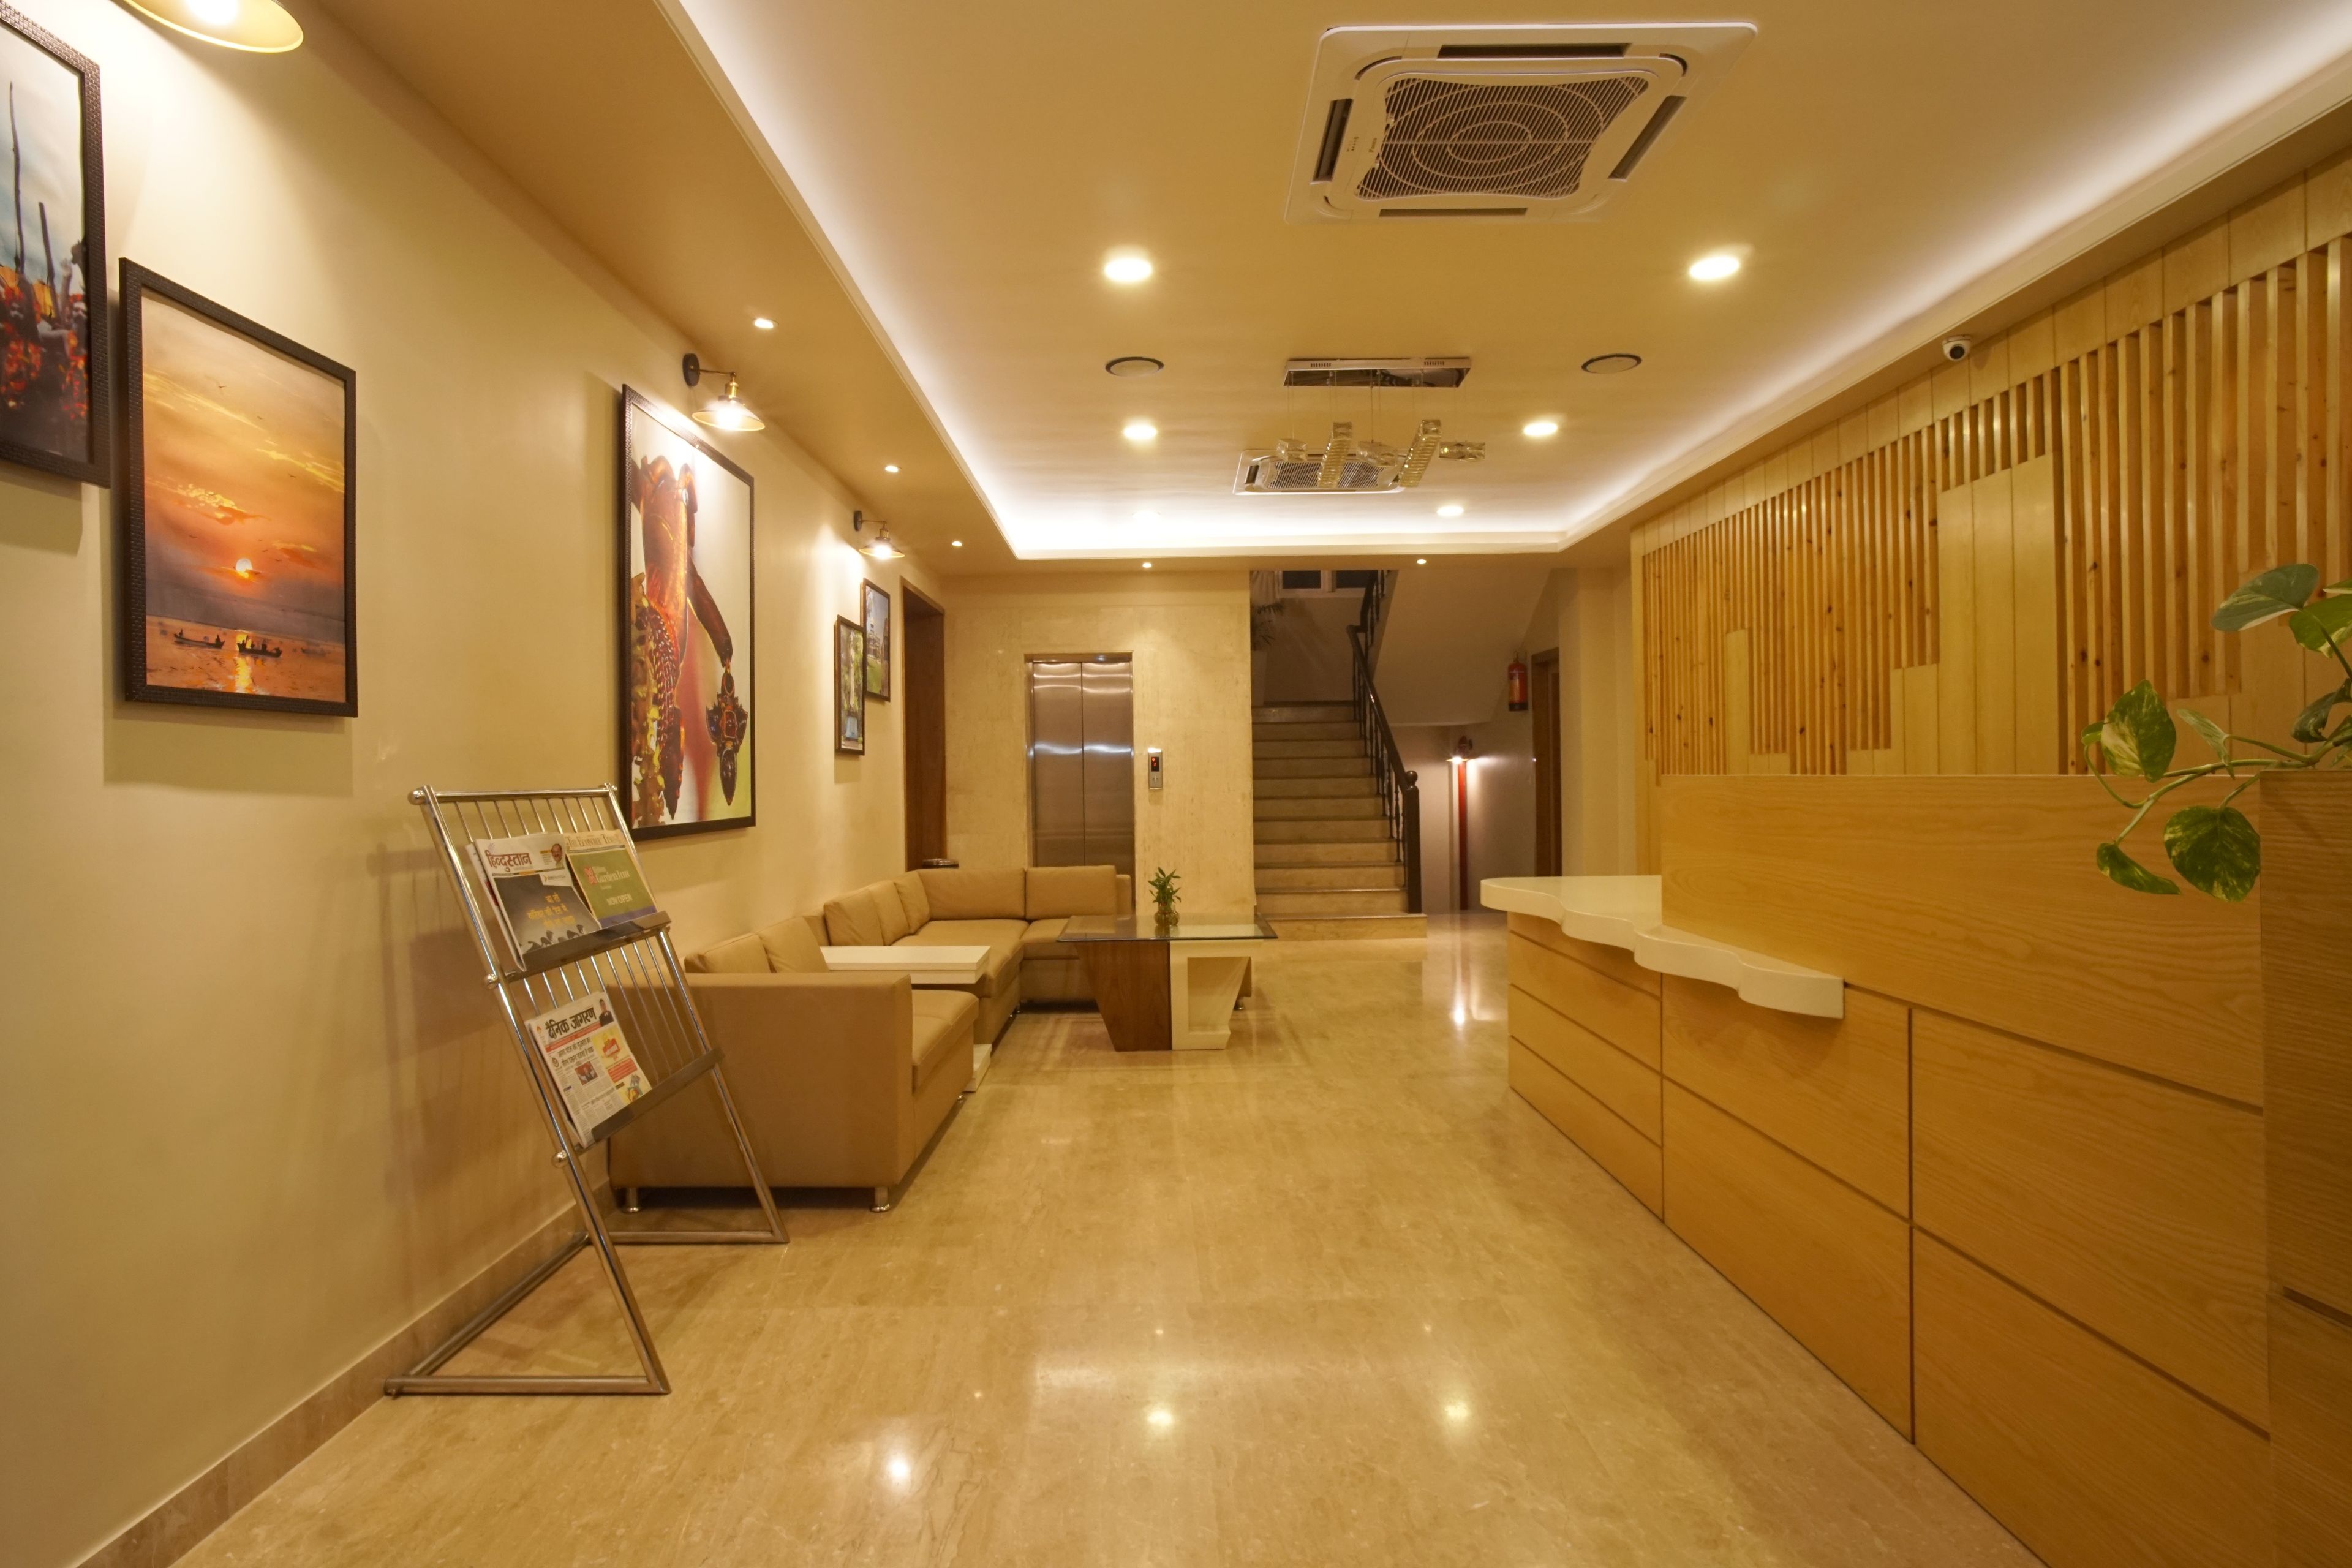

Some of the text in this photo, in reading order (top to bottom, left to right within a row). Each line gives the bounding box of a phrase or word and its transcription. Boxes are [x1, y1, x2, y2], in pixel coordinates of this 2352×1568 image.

[484, 849, 532, 872] हिन्दुस्तान
[617, 894, 632, 904] OPEN
[545, 1007, 597, 1039] दैनिक जागरण
